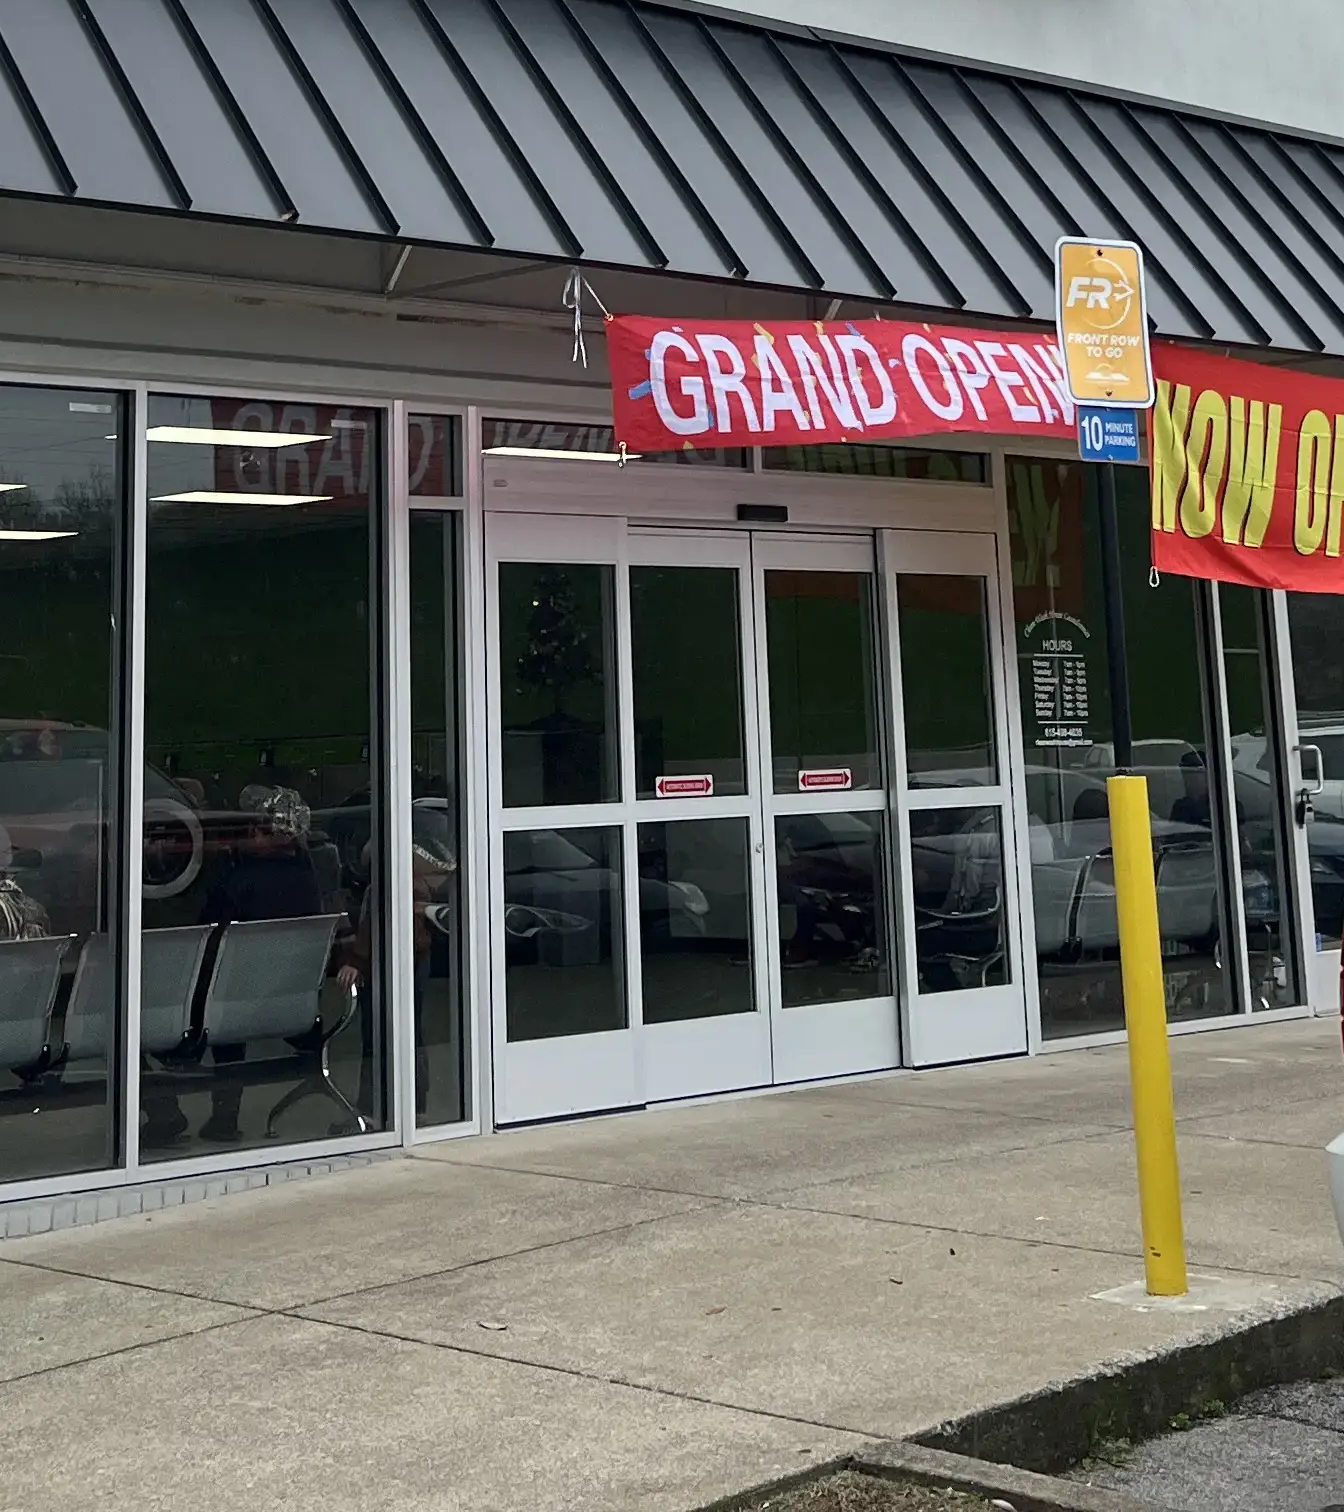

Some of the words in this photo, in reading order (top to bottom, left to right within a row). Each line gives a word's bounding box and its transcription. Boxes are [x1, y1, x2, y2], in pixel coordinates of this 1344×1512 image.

[1065, 276, 1112, 310] FR
[1067, 332, 1108, 346] FRONT
[1110, 334, 1140, 347] ROW
[1086, 346, 1103, 358] TO
[1104, 347, 1123, 358] GO
[648, 329, 898, 436] GRAND
[1080, 415, 1104, 452] 10
[1104, 421, 1134, 434] MINUTE
[1103, 434, 1137, 448] PARKING
[1152, 378, 1283, 548] NOW
[1042, 639, 1073, 652] HOURS
